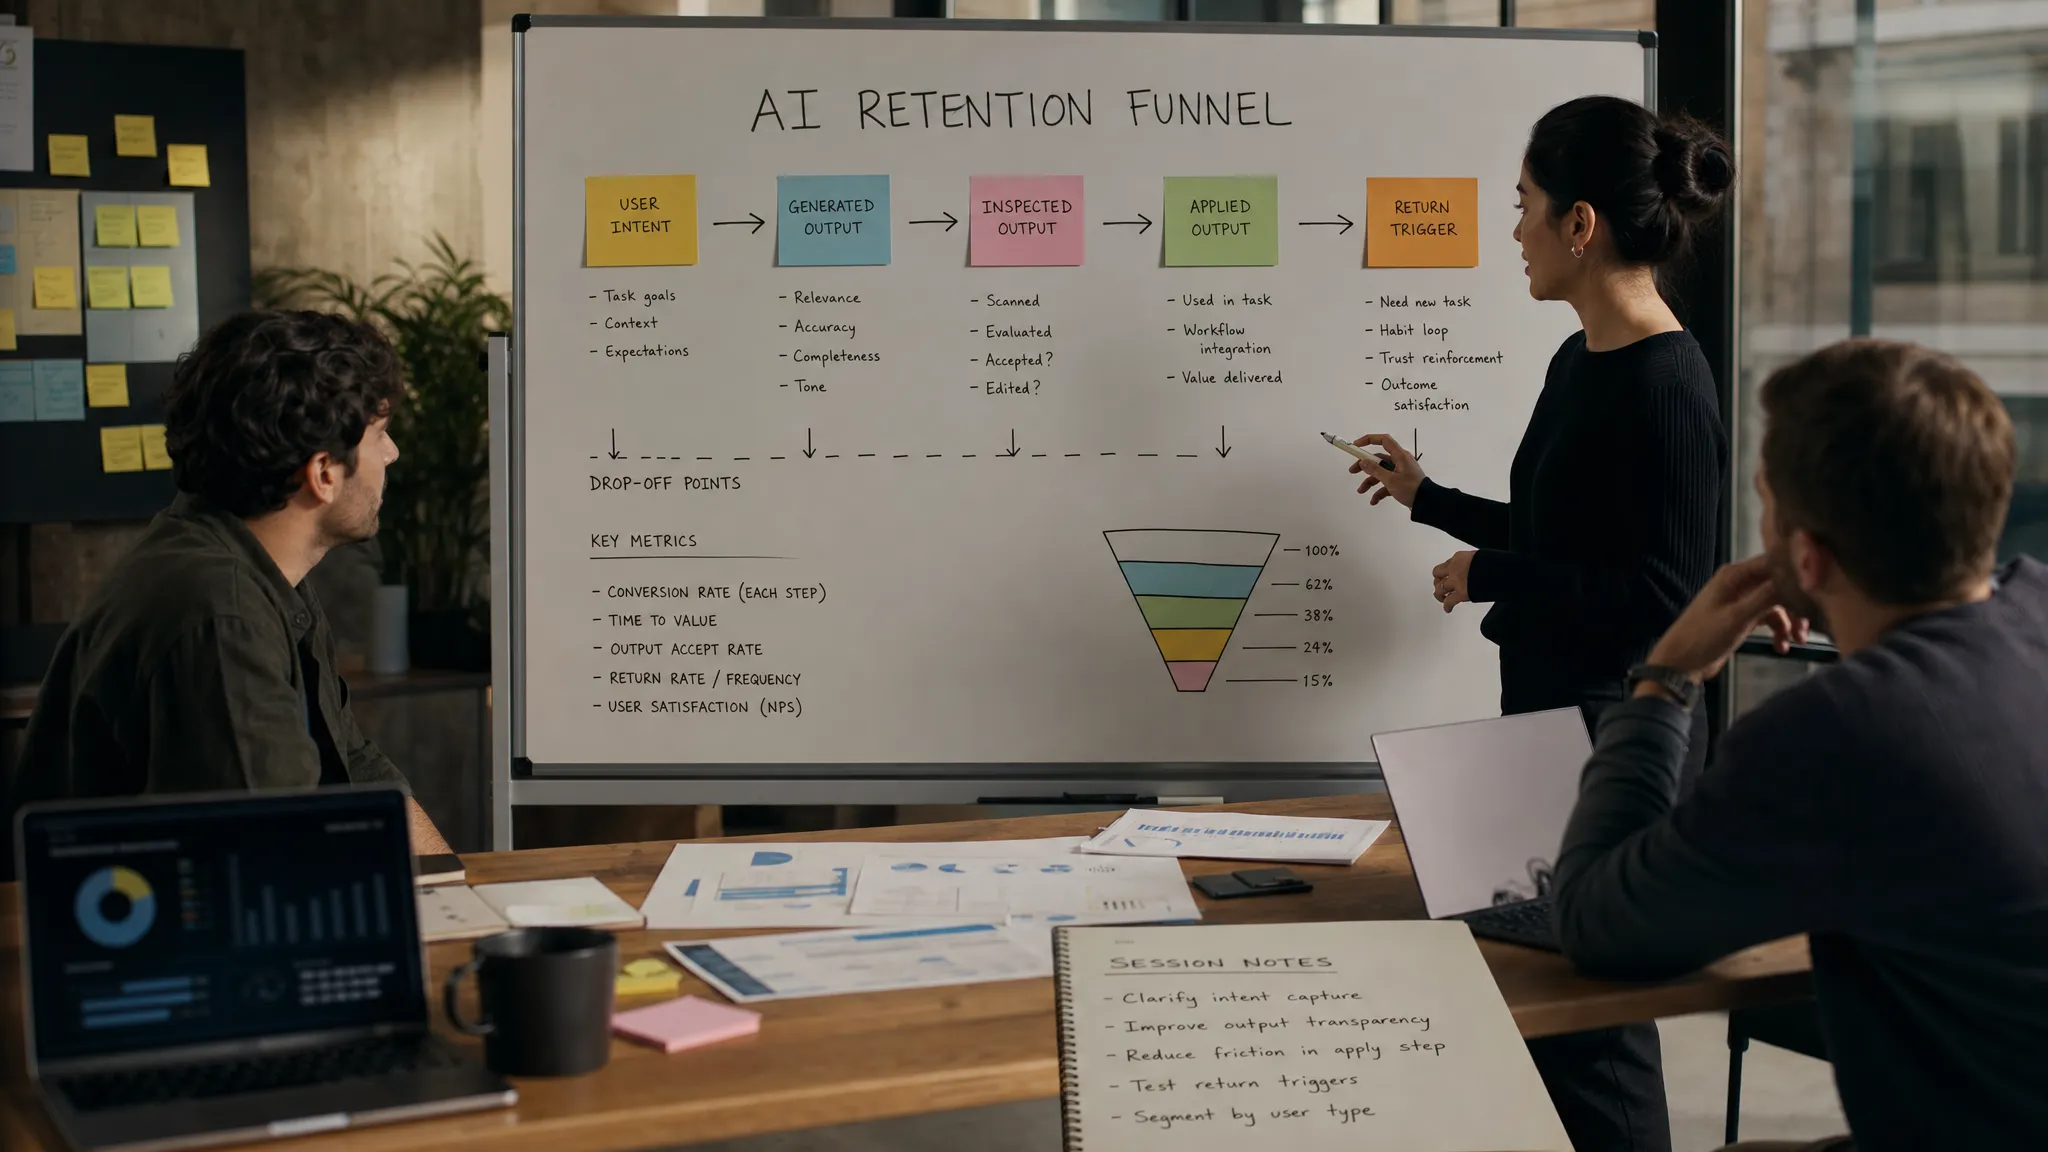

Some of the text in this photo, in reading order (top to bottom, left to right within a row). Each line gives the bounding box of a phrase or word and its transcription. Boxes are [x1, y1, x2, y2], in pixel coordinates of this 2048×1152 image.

[750, 88, 1293, 133] AI RETENTION FUNNEL
[619, 196, 660, 211] USER
[788, 198, 875, 214] GENERATED
[981, 199, 1073, 215] INSPECTED
[1189, 199, 1251, 214] APPLIED
[1394, 199, 1450, 215] RETURN
[609, 219, 672, 234] INTENT
[804, 220, 863, 236] OUTPUT
[997, 221, 1058, 236] OUTPUT
[1191, 221, 1251, 237] OUTPUT
[1389, 222, 1458, 237] TRIGGER
[602, 288, 676, 308] Task goals
[793, 290, 862, 304] Relevance
[986, 293, 1041, 307] Scanned
[1182, 292, 1273, 307] Used in task
[1380, 294, 1472, 309] Need new task
[604, 315, 659, 330] Context
[794, 318, 856, 340] Accuracy
[1183, 321, 1245, 337] Workflow
[986, 324, 1053, 339] Evaluated
[1379, 322, 1449, 342] Habit loop
[605, 343, 689, 364] Expectations
[793, 348, 881, 368] Completeness
[1200, 341, 1272, 361] integration
[1378, 349, 1504, 365] Trust reinforcement
[1181, 369, 1283, 384] Value delivered
[1381, 377, 1438, 392] Outcome
[793, 378, 828, 393] Tone
[1394, 396, 1470, 412] satisfaction
[589, 475, 741, 492] DROP-OFF POINTS
[591, 533, 697, 549] KEY METRICS
[1305, 544, 1340, 557] 100%
[607, 581, 827, 604] CONVERSION RATE (EACH STEP)
[1305, 578, 1333, 591] 62%
[608, 613, 718, 627] TIME TO VALUE
[1304, 608, 1334, 622] 38%
[610, 642, 763, 656] OUTPUT ACCEPT RATE
[1303, 640, 1334, 655] 24%
[609, 671, 662, 685] RETURN
[670, 672, 706, 686] RATE
[726, 672, 802, 687] FREQUENCY
[1303, 673, 1333, 688] 15%
[608, 696, 803, 719] USER SATISFACTION (NPS)
[1109, 956, 1333, 970] SESSION NOTES
[1122, 990, 1362, 1009] Clarify intent capture
[1123, 1015, 1430, 1037] Improve output transparency
[1125, 1039, 1446, 1063] Reduce friction in apply step
[1129, 1074, 1358, 1094] Test return triggers
[1134, 1103, 1376, 1130] Segment by user type
